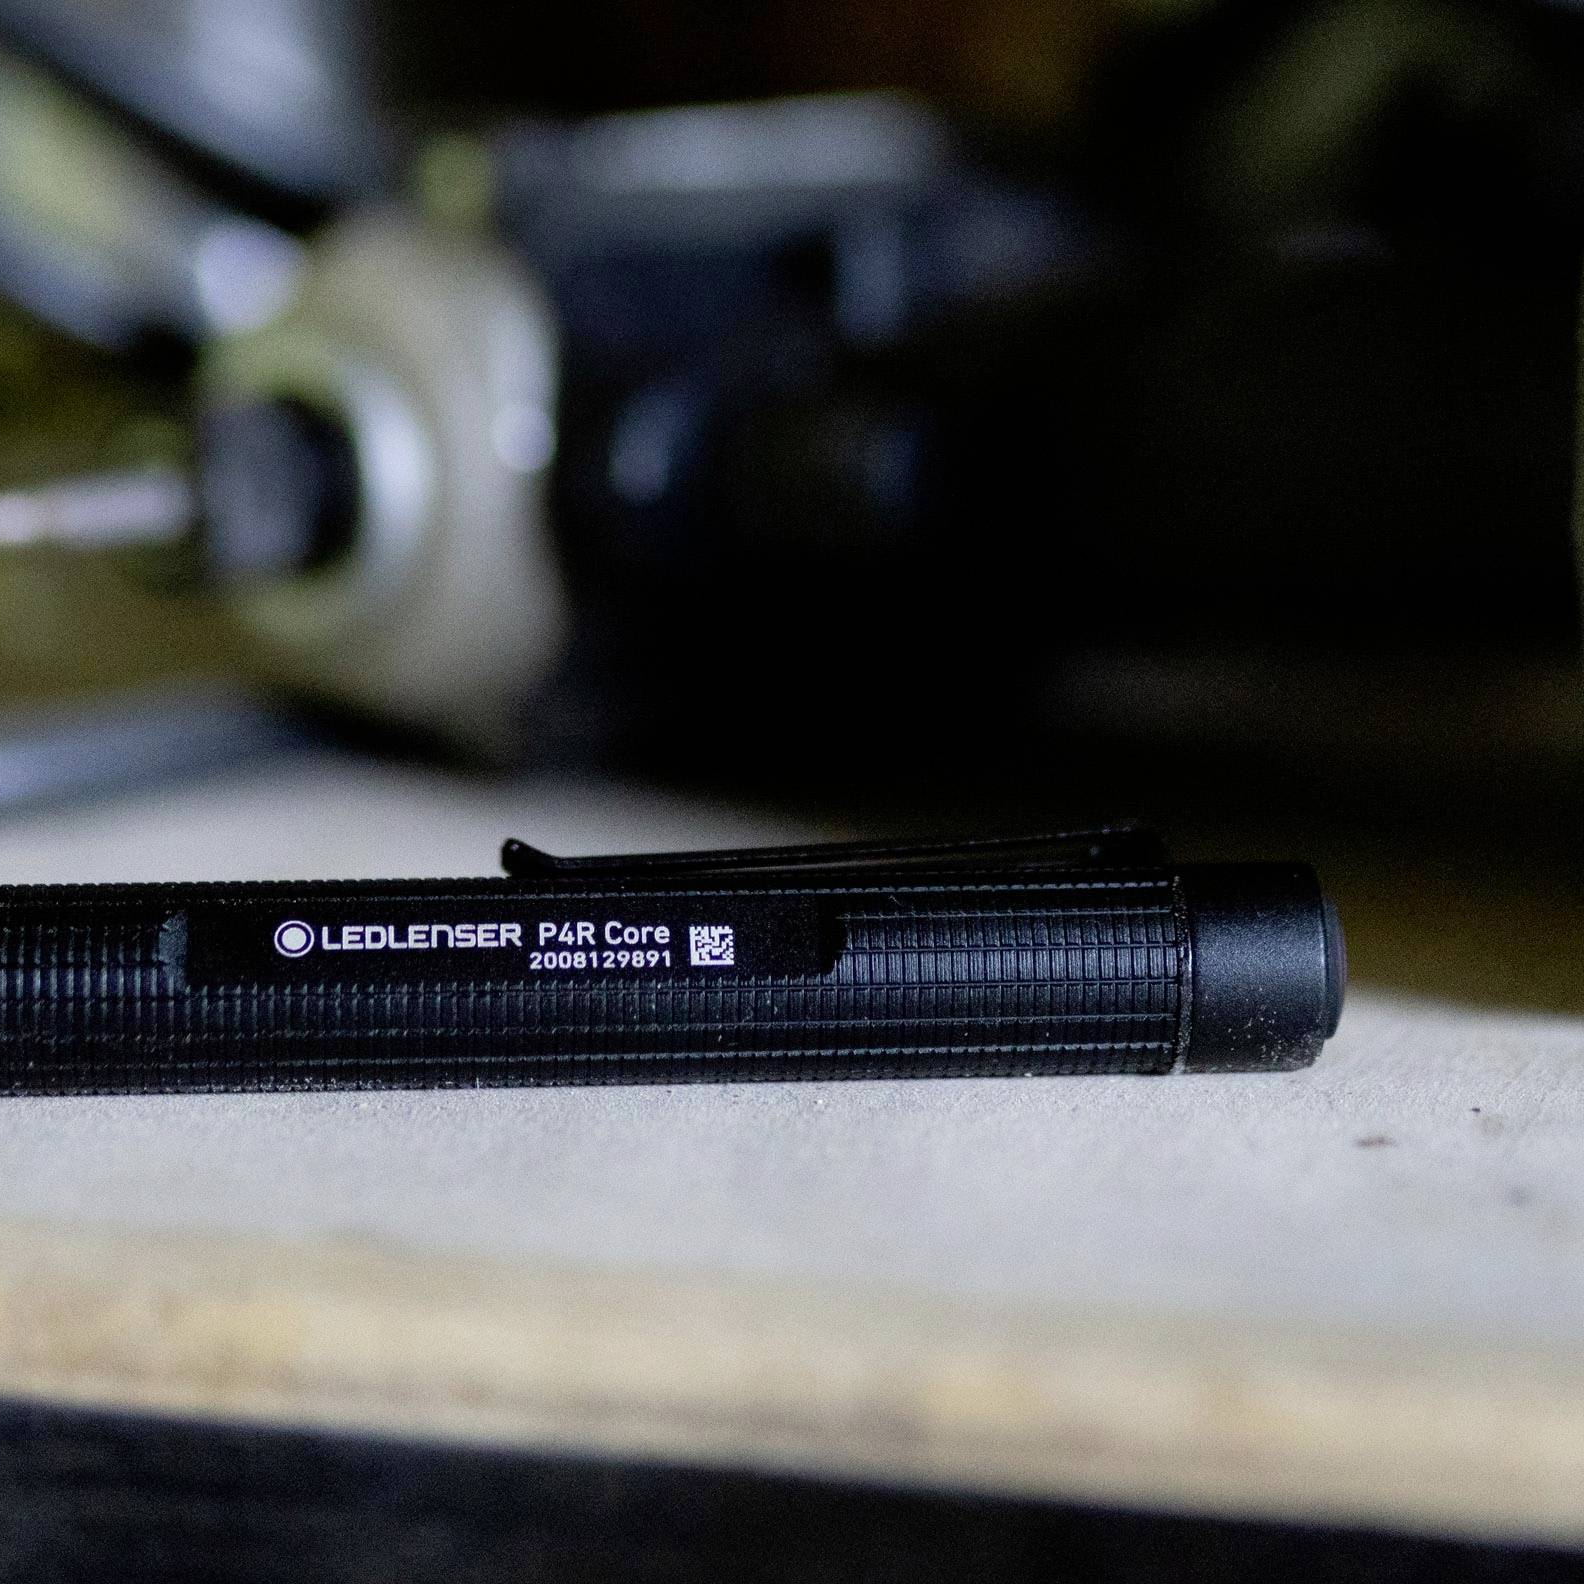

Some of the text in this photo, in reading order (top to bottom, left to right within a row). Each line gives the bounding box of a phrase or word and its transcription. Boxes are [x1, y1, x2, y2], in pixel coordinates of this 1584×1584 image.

[321, 920, 671, 951] LEDLENSER P4R Core
[529, 950, 672, 971] 2008129891
